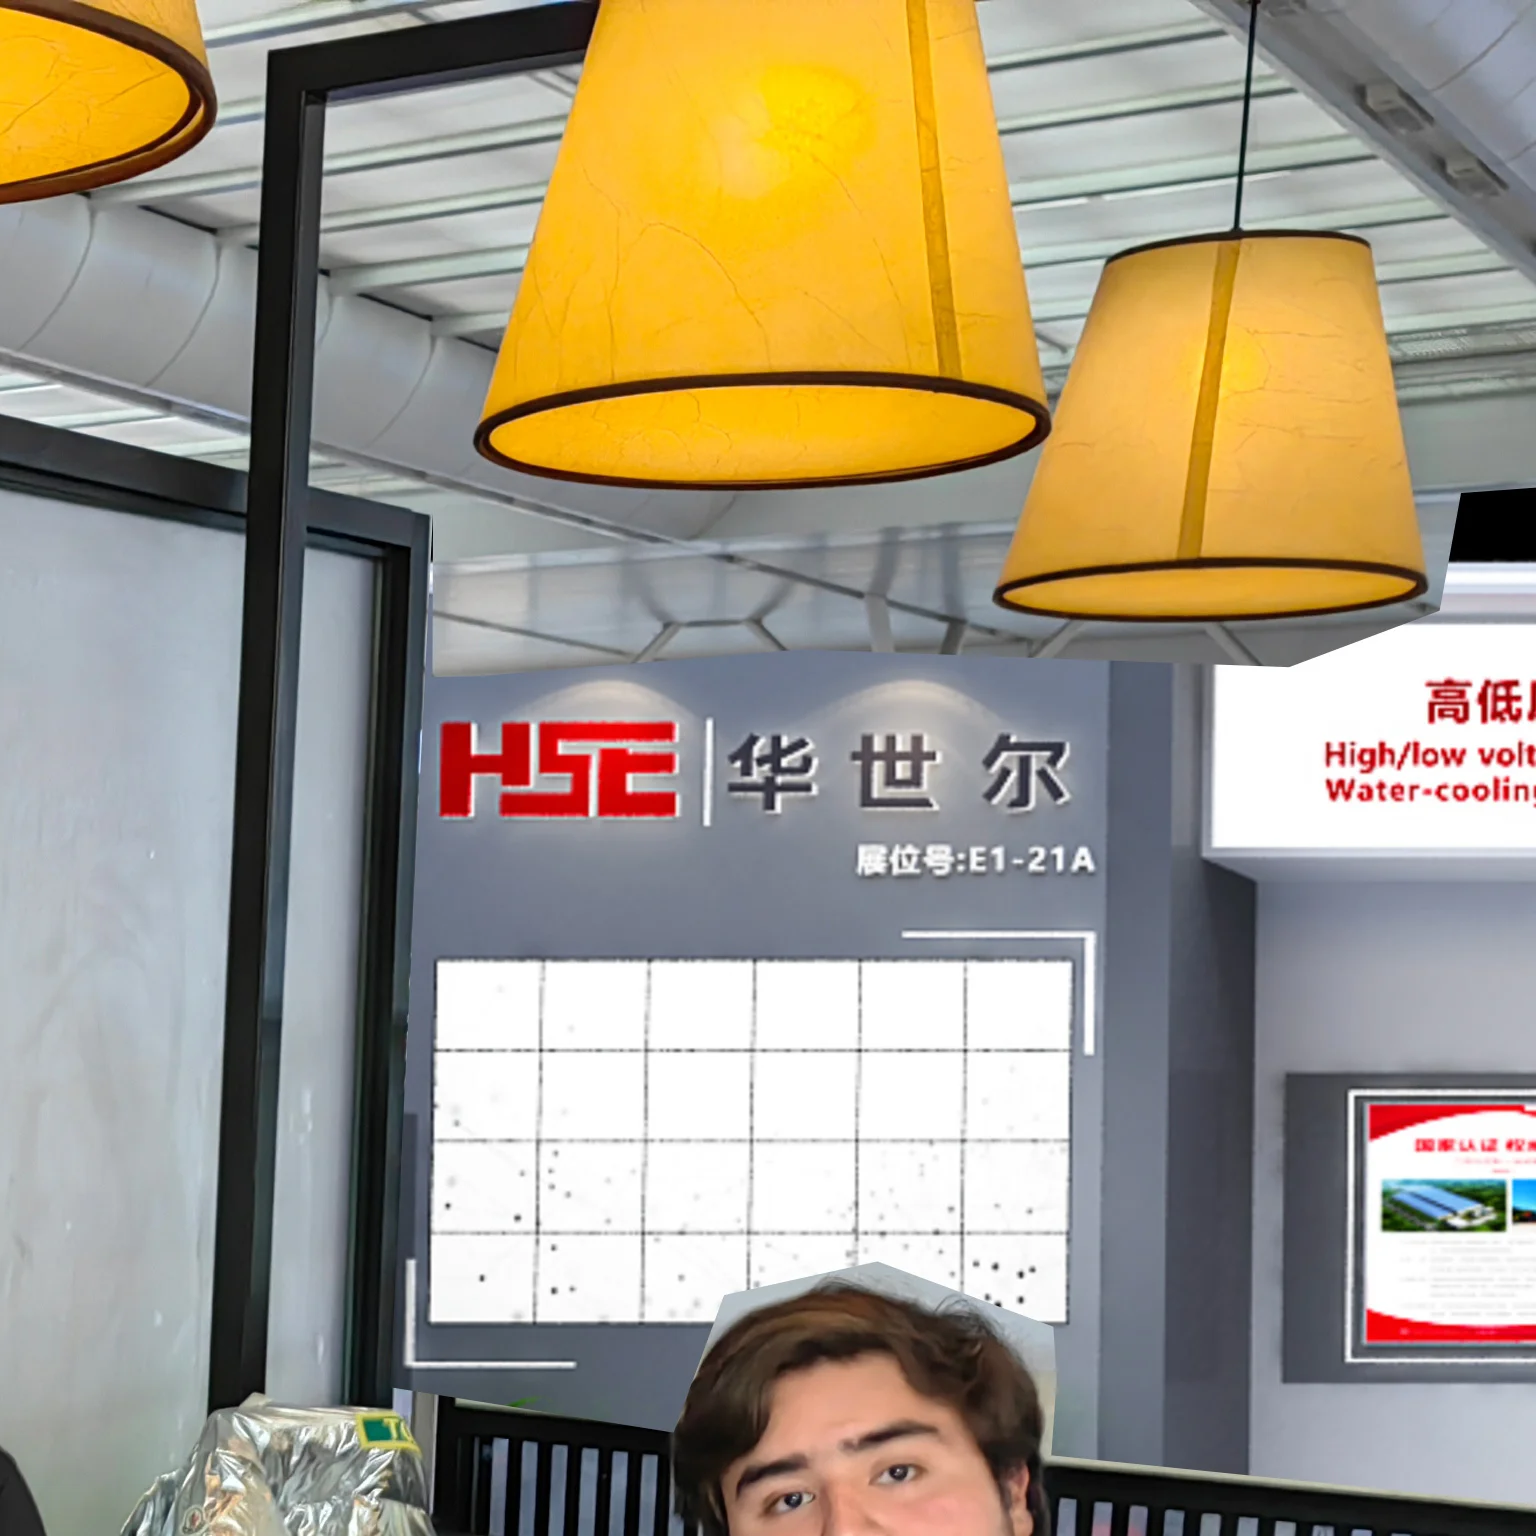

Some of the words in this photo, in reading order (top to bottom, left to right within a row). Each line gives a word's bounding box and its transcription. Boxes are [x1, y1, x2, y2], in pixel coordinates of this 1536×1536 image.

[1425, 678, 1536, 724] 高低
[438, 720, 678, 818] HSE
[725, 731, 1070, 814] 华世尔
[1324, 740, 1467, 774] High/low
[1324, 776, 1536, 808] Water-coolin
